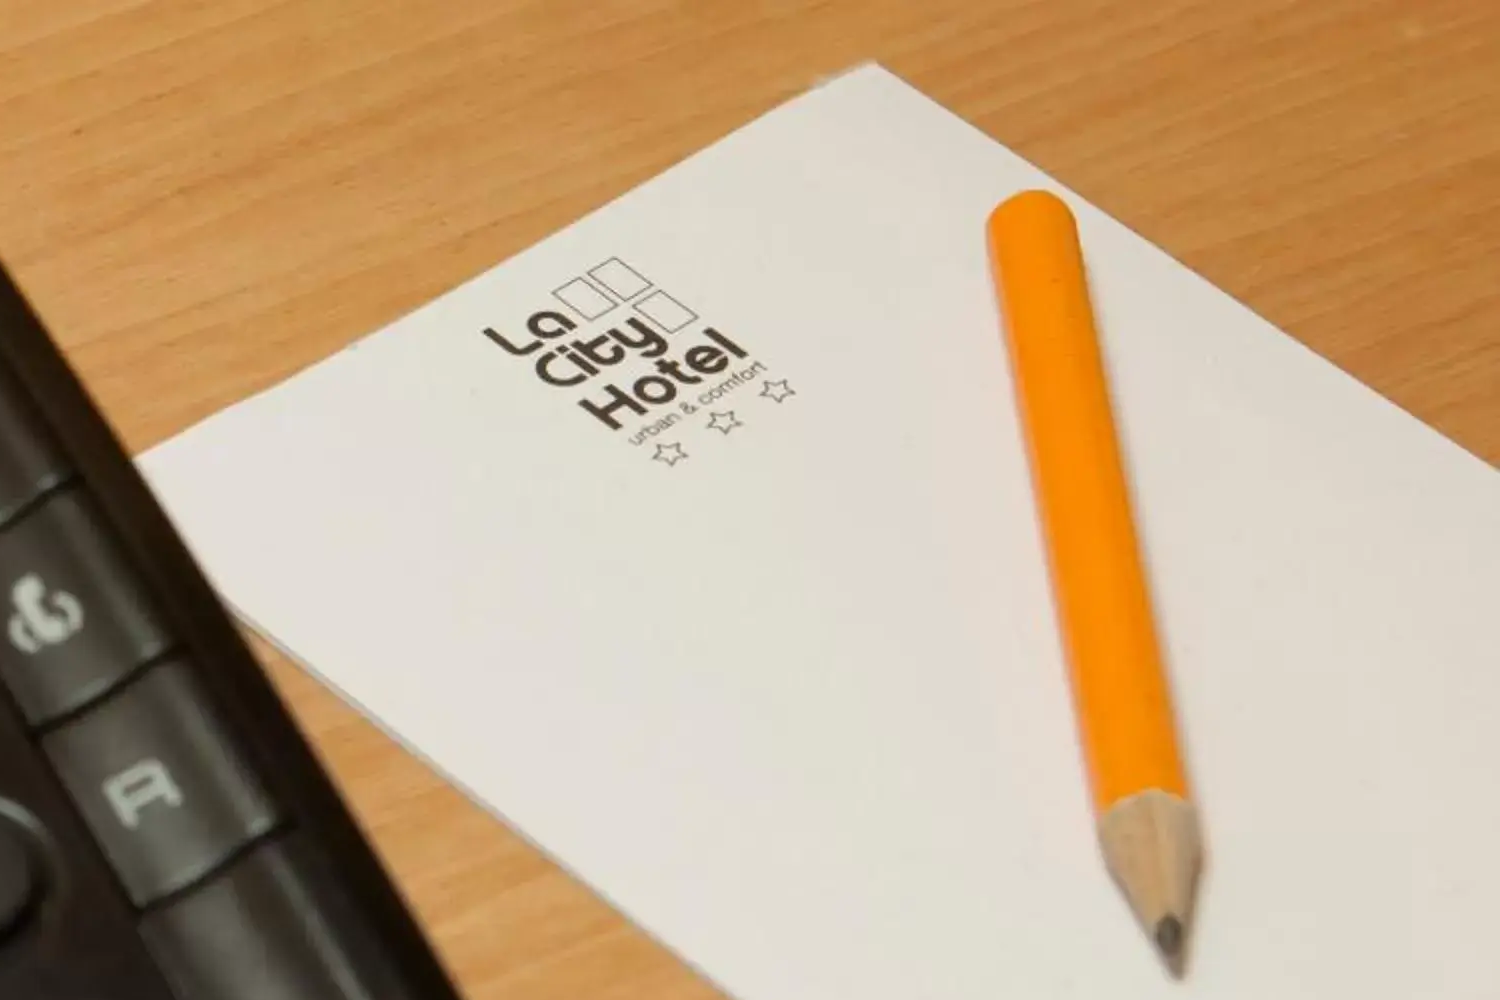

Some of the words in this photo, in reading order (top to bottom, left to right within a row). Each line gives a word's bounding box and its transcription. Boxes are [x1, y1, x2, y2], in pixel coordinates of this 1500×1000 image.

[482, 310, 578, 356] La
[535, 317, 669, 387] City
[577, 327, 749, 430] Hotel
[627, 412, 682, 446] urban
[678, 400, 700, 415] &
